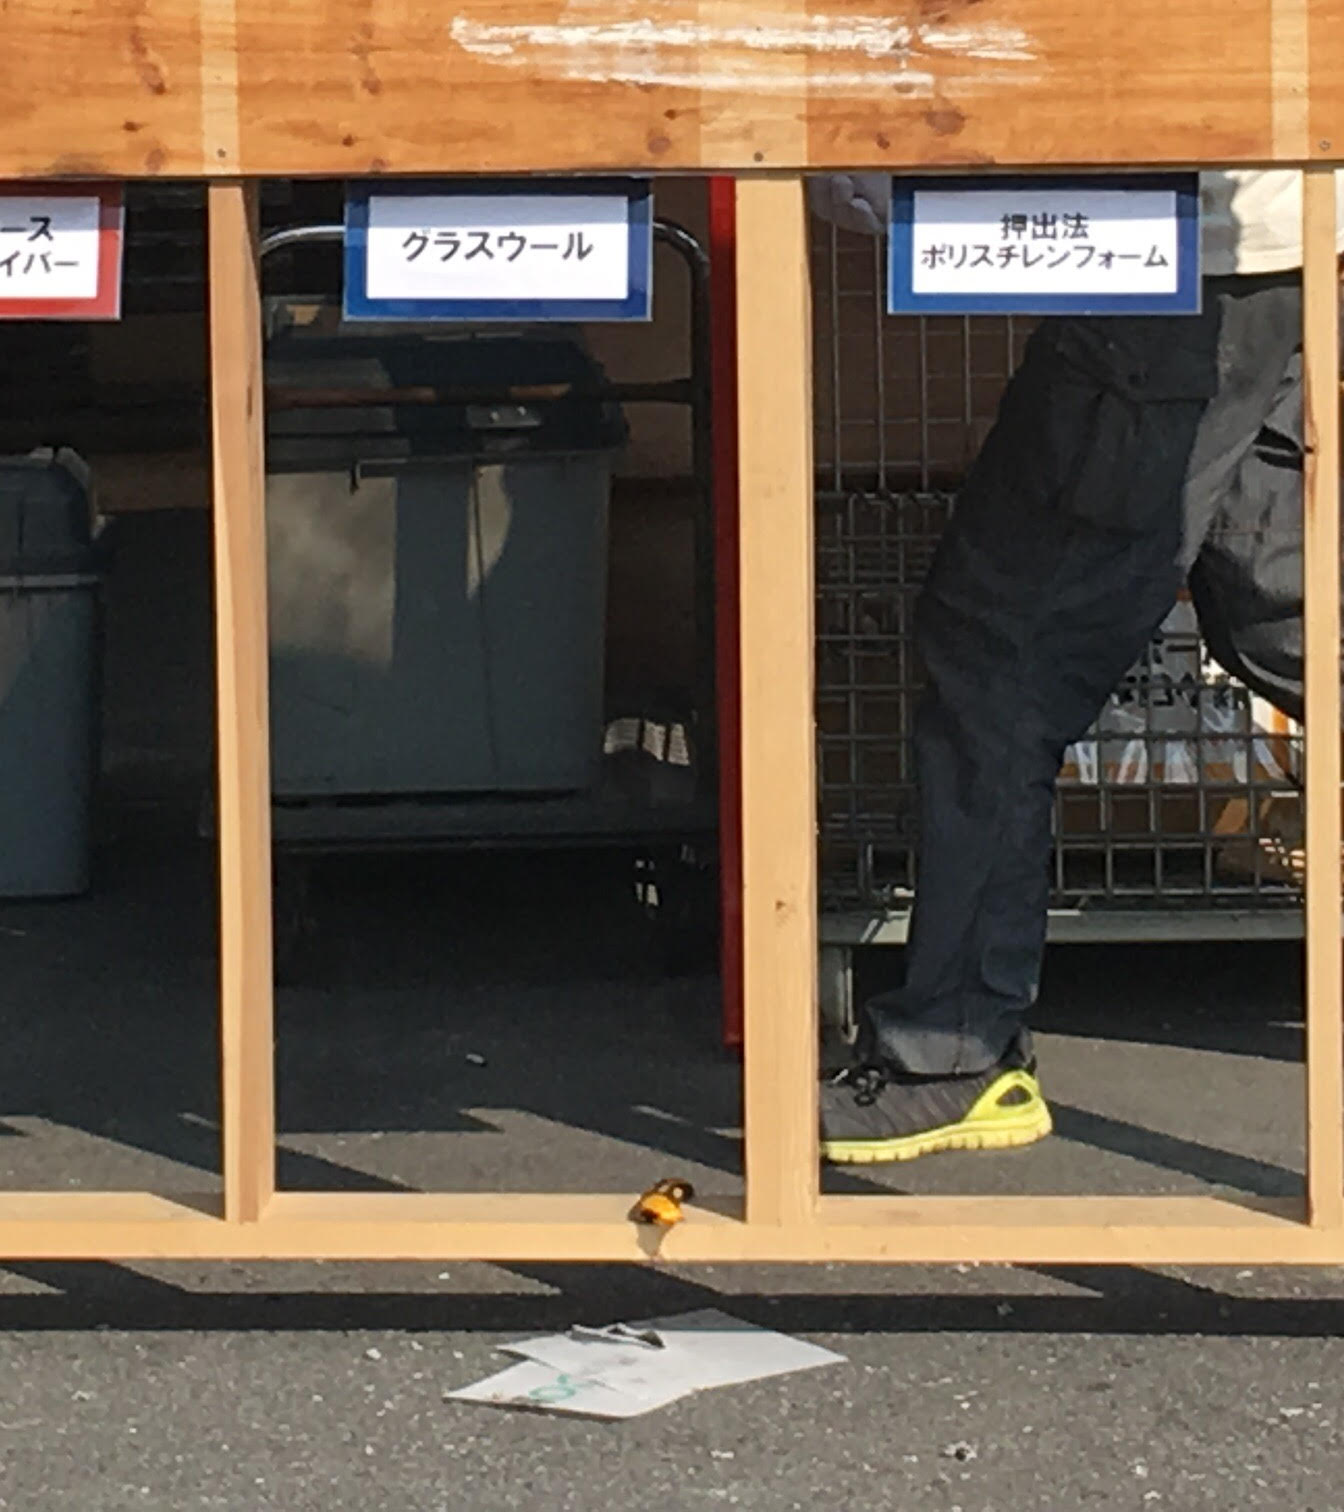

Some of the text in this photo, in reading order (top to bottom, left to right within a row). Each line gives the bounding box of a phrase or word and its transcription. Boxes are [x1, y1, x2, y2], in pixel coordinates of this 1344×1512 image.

[1000, 212, 1090, 240] 押出法
[402, 229, 594, 263] グラスウール
[921, 244, 1169, 270] ポリスチレンフォーム
